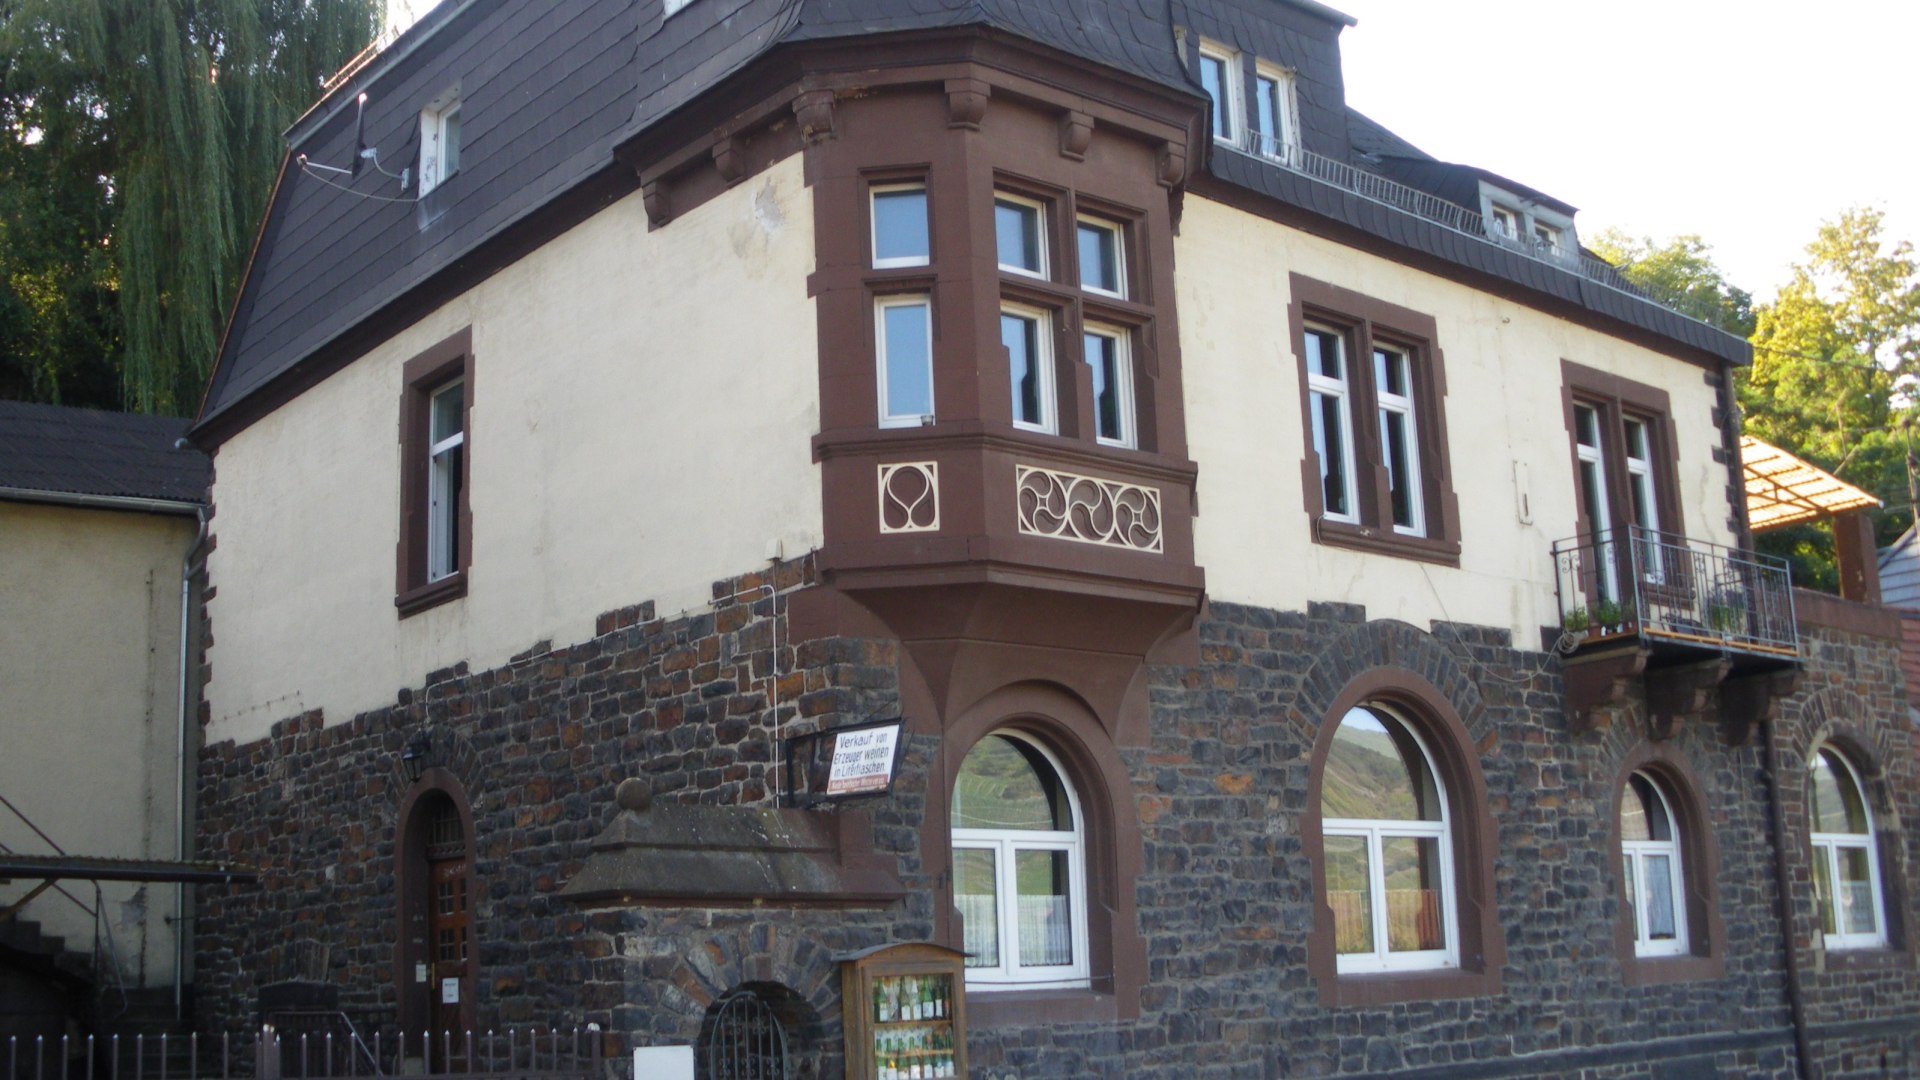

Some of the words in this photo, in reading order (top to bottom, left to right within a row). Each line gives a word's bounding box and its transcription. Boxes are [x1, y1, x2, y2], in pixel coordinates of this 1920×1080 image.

[840, 731, 873, 748] Verkauf
[876, 733, 888, 743] von
[834, 765, 841, 777] in
